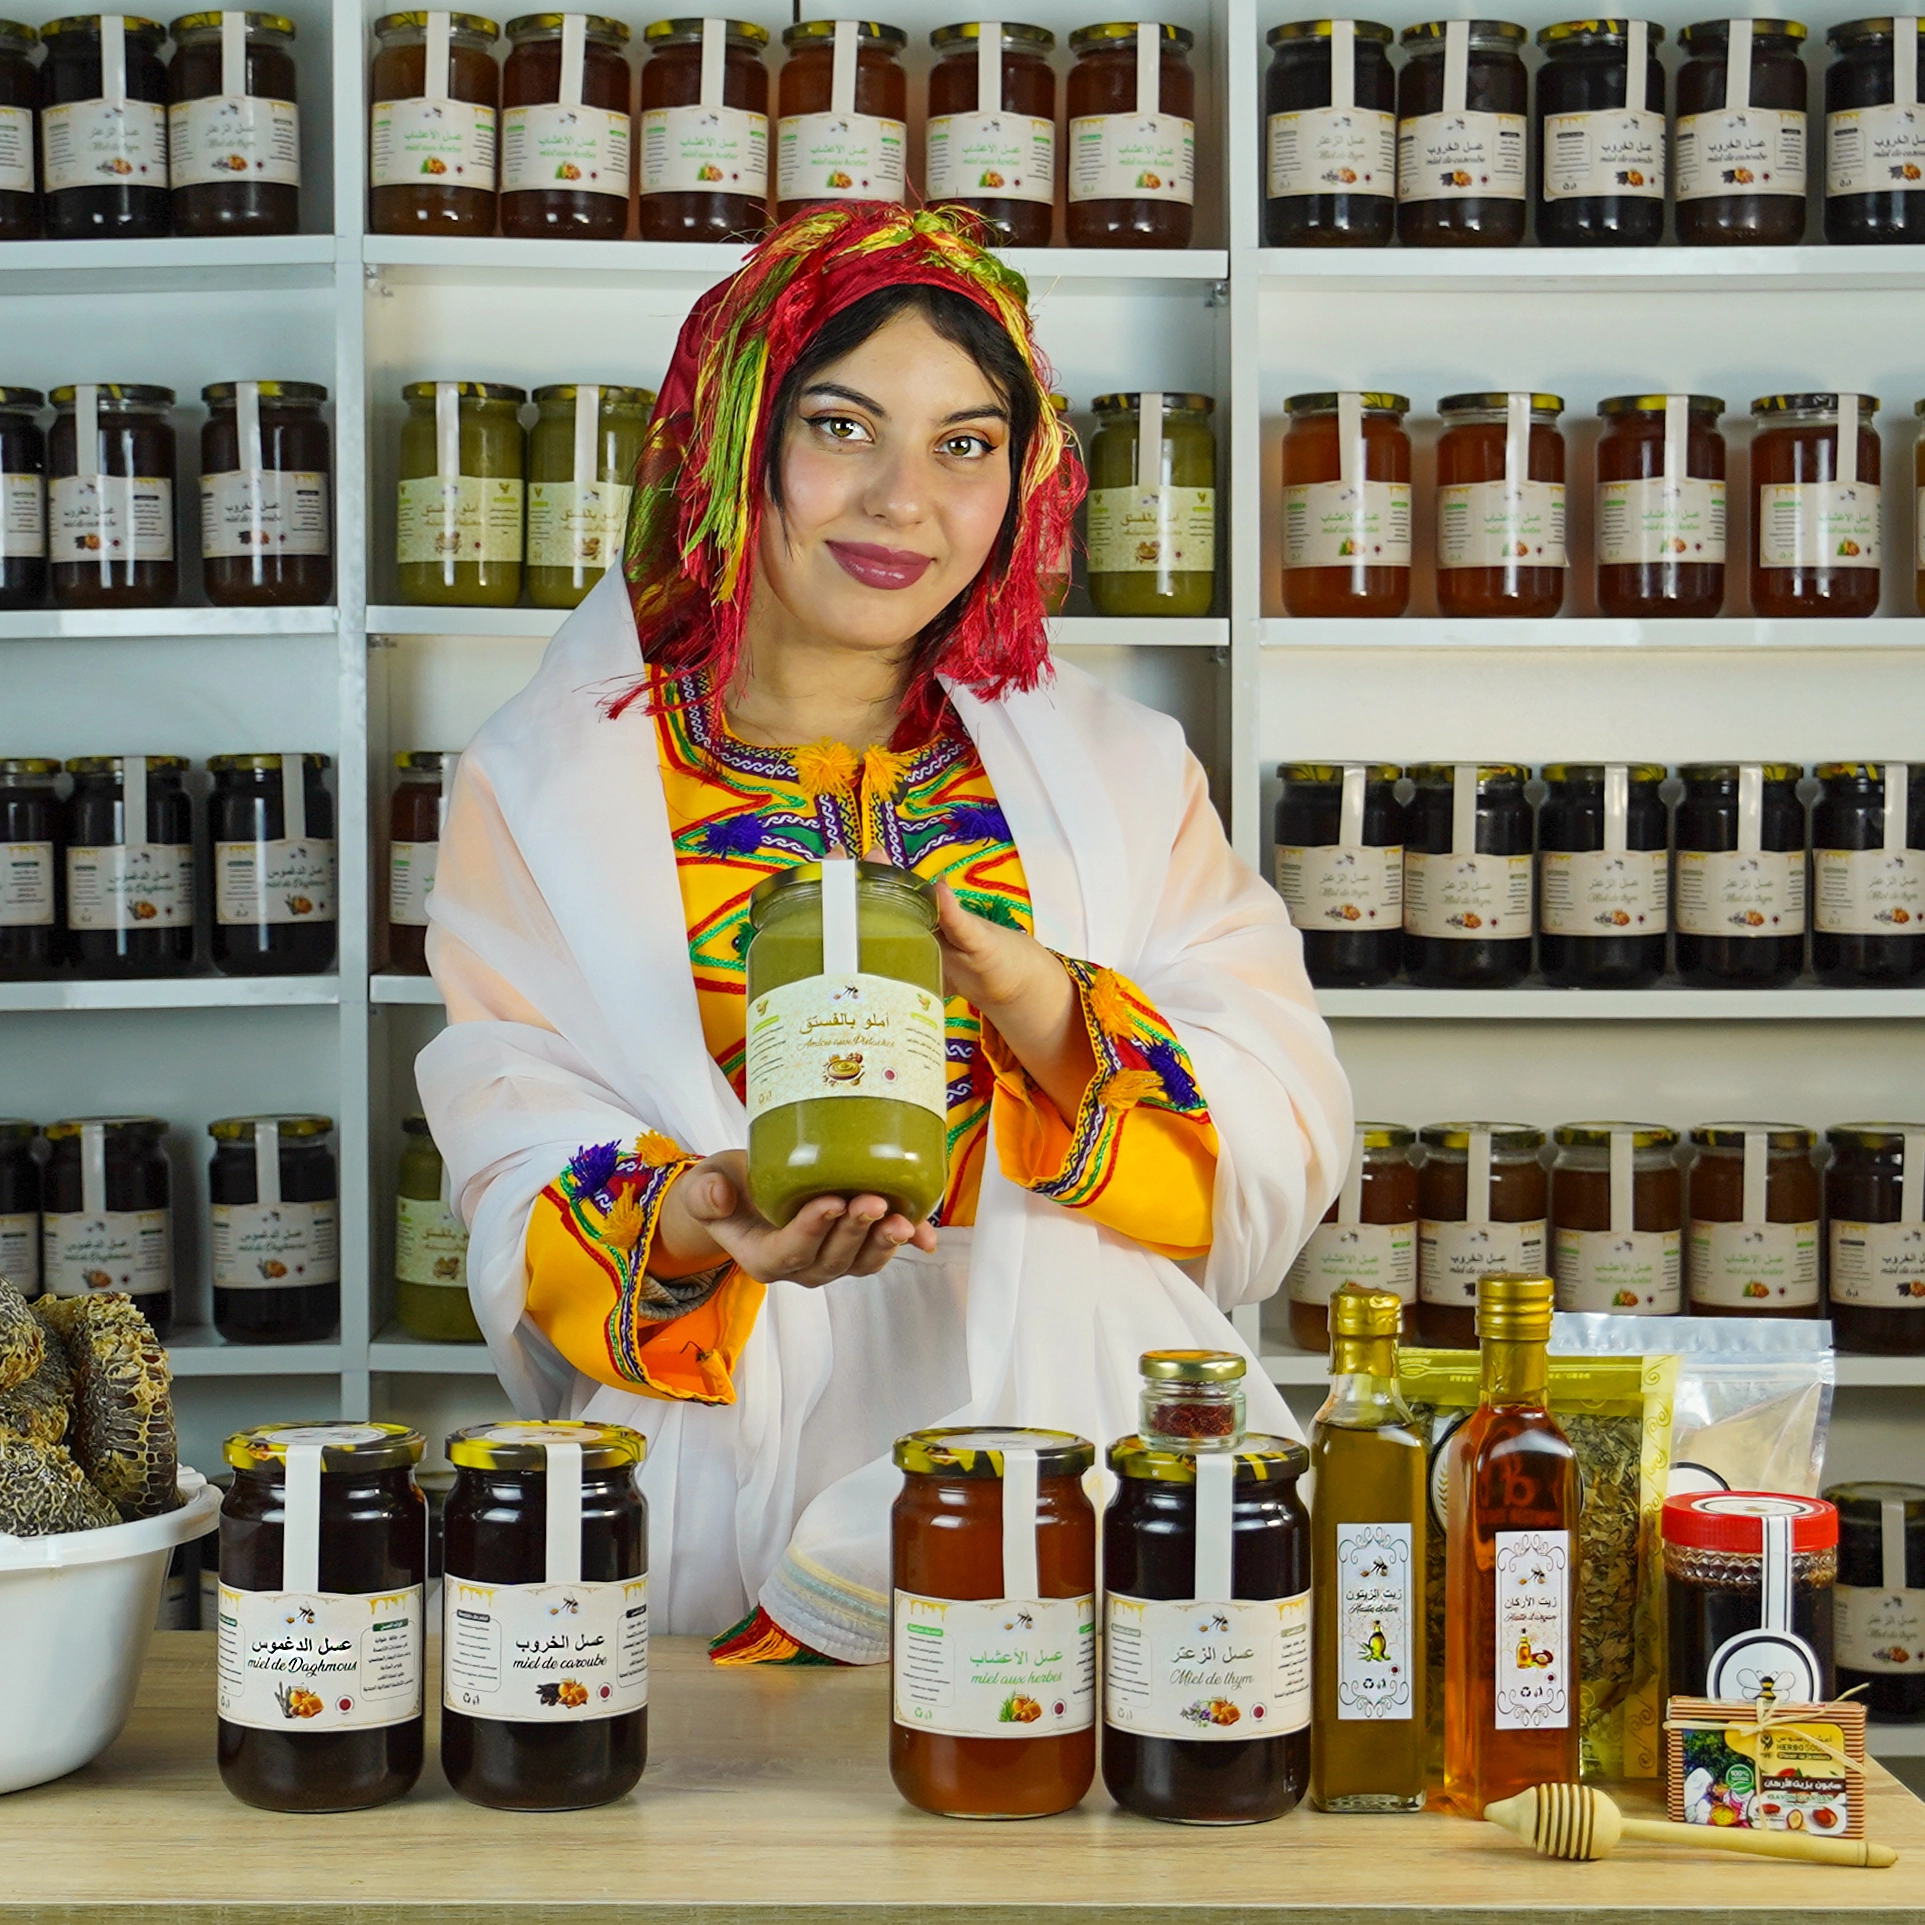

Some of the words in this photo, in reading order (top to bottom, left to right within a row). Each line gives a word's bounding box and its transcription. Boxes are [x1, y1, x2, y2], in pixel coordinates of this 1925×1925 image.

[799, 1012, 856, 1035] بالفستق
[1346, 1588, 1380, 1601] الزيتون
[1382, 1588, 1402, 1600] زيت
[1538, 1597, 1557, 1608] زيت
[251, 1636, 313, 1654] الدغموس
[317, 1637, 353, 1655] عسل
[515, 1634, 569, 1653] الخروب
[574, 1634, 605, 1651] عسل
[512, 1656, 541, 1669] miel
[541, 1656, 559, 1669] de
[559, 1653, 607, 1669] caroube
[969, 1647, 1028, 1667] الأعشاب
[1033, 1649, 1063, 1666] عسل
[1170, 1646, 1217, 1664] الزعتر
[1222, 1646, 1255, 1663] عسل
[247, 1657, 271, 1670] miel
[271, 1657, 287, 1671] de
[288, 1656, 358, 1678] Daghmous
[970, 1671, 1000, 1684] miel
[1000, 1674, 1026, 1685] aux
[1026, 1669, 1063, 1684] herbes
[1169, 1668, 1204, 1686] Miel
[1204, 1671, 1222, 1685] de
[1223, 1671, 1255, 1690] thym
